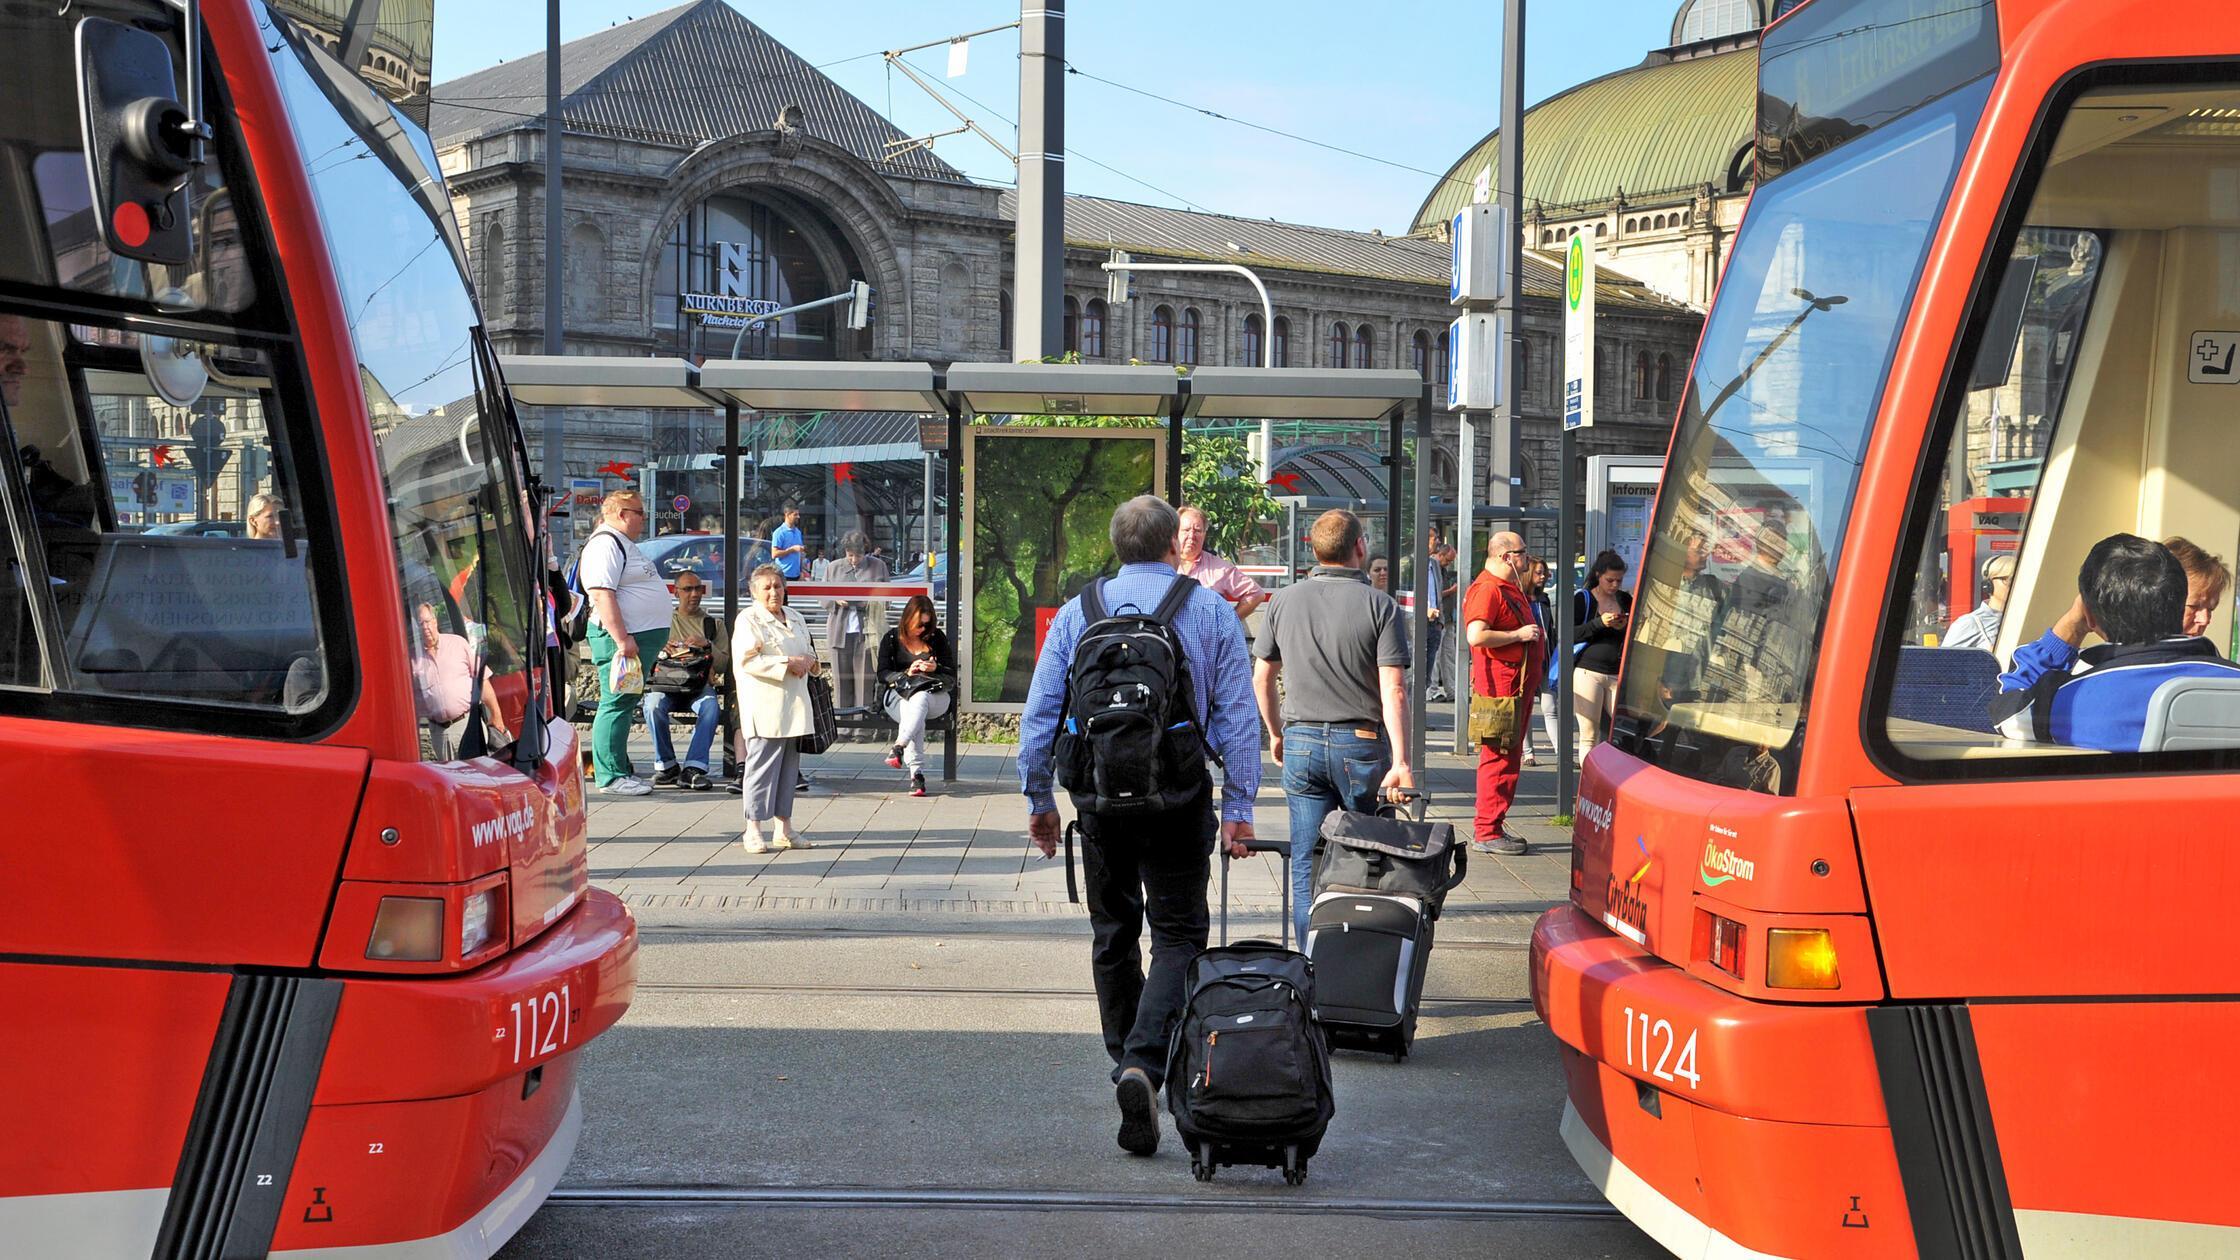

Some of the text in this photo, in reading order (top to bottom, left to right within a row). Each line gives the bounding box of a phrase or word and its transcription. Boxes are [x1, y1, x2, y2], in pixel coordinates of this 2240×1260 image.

[1612, 484, 1657, 496] Informa
[576, 494, 604, 505] Dank
[1978, 516, 1999, 525] VAG
[472, 793, 534, 848] www.vag.de
[1704, 838, 1754, 881] ÖkoStrom
[1606, 872, 1648, 931] CityBahn
[510, 985, 570, 1064] 1121
[495, 1027, 506, 1039] Z2
[1624, 1006, 1701, 1090] 1124
[368, 1142, 384, 1154] Z2
[256, 1174, 273, 1186] Z2
